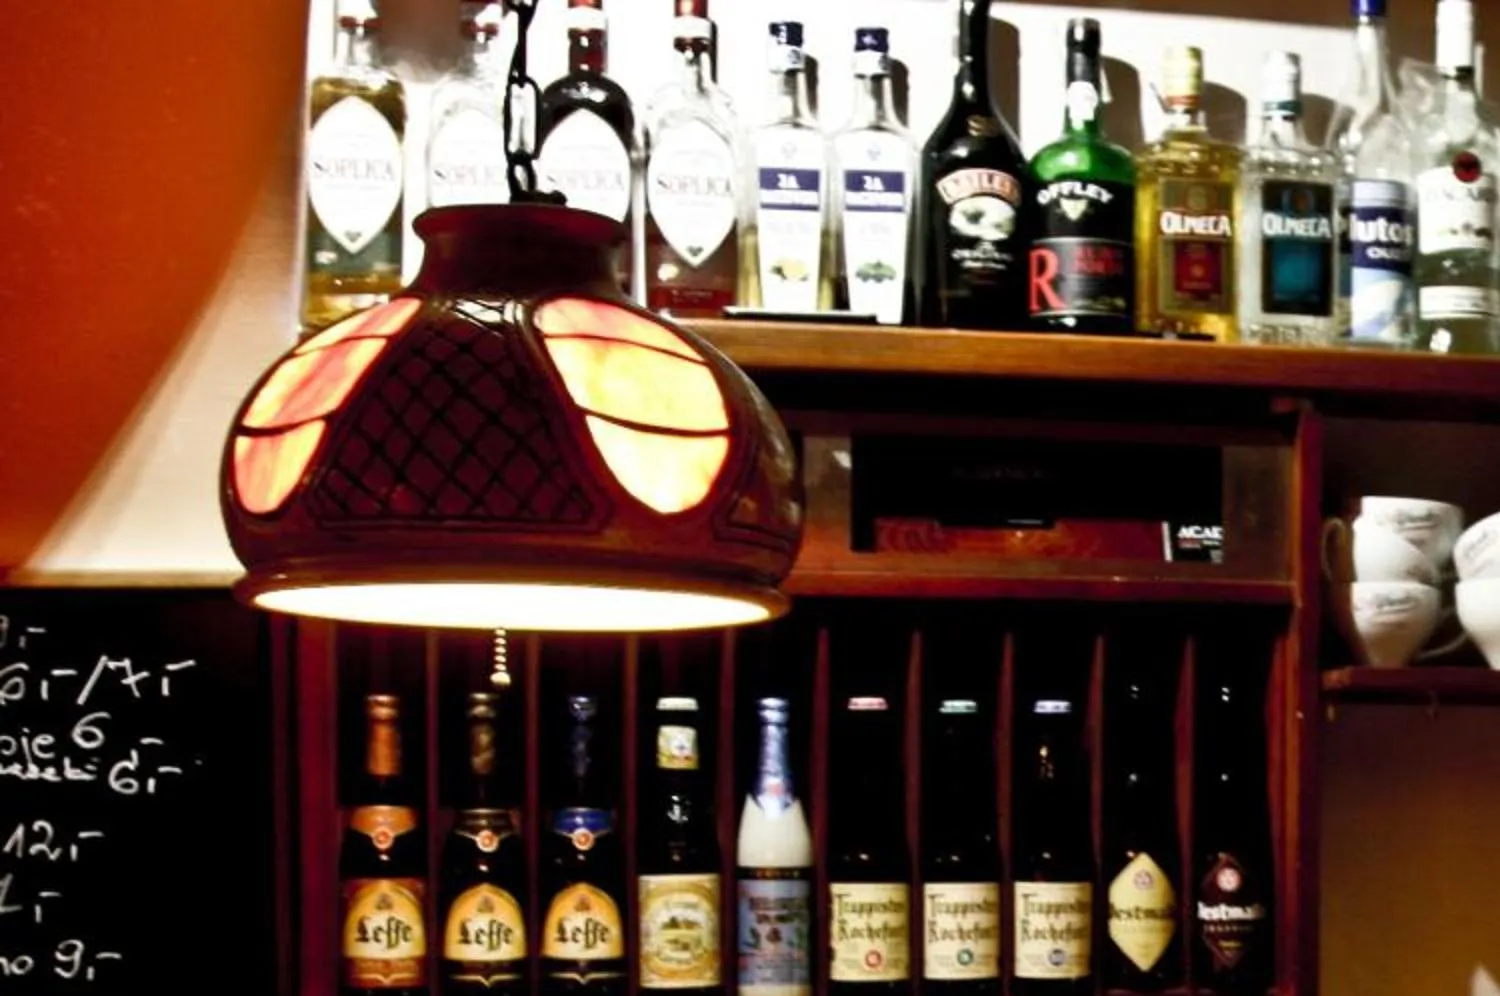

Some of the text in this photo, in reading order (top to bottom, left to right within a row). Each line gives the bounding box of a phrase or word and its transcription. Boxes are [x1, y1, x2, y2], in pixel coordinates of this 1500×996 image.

[1037, 181, 1113, 205] OFFLEY
[1160, 210, 1232, 237] OLMECA
[1262, 212, 1332, 239] OLMECA
[1029, 246, 1066, 317] R
[355, 917, 413, 950] Leffe
[458, 918, 515, 951] Leffe
[555, 917, 612, 950] Leffe
